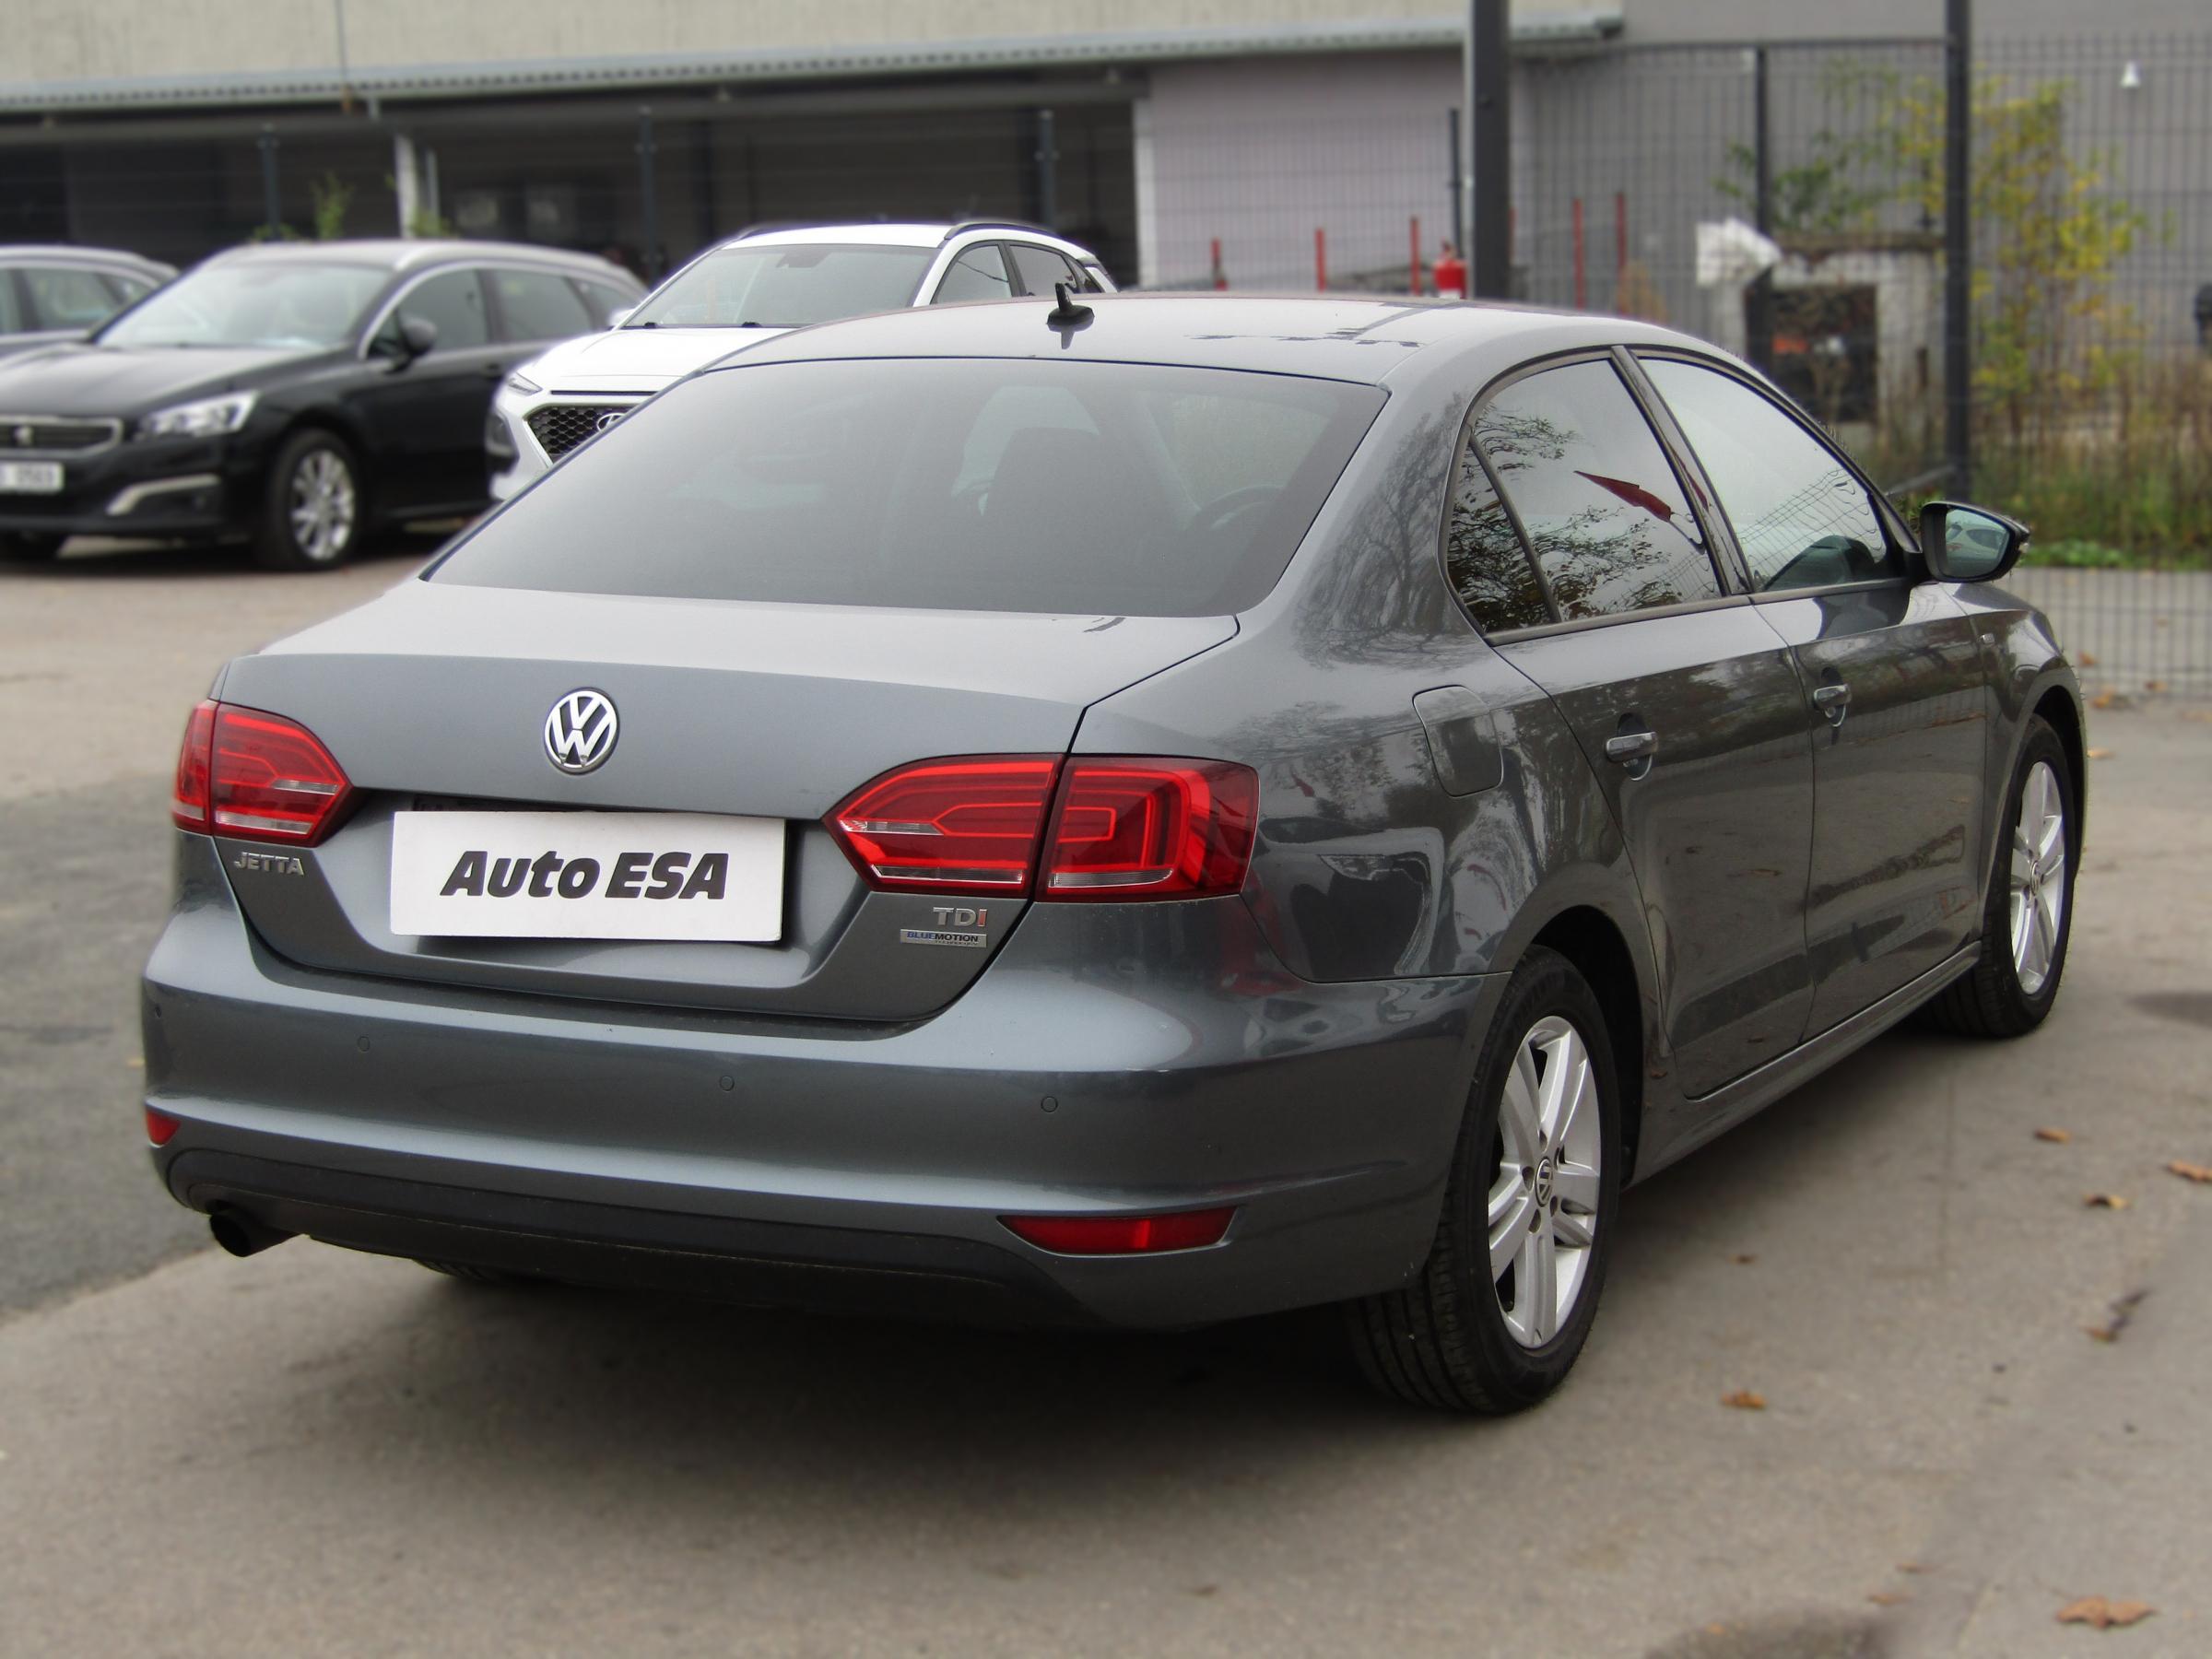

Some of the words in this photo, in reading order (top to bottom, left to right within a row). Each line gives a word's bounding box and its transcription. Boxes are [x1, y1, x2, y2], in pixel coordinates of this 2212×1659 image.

[547, 689, 618, 768] VW
[233, 851, 305, 877] JETTA
[439, 851, 601, 900] Auto
[605, 852, 729, 900] ESA
[933, 906, 988, 927] TDI
[906, 931, 980, 942] BLUEMOTION
